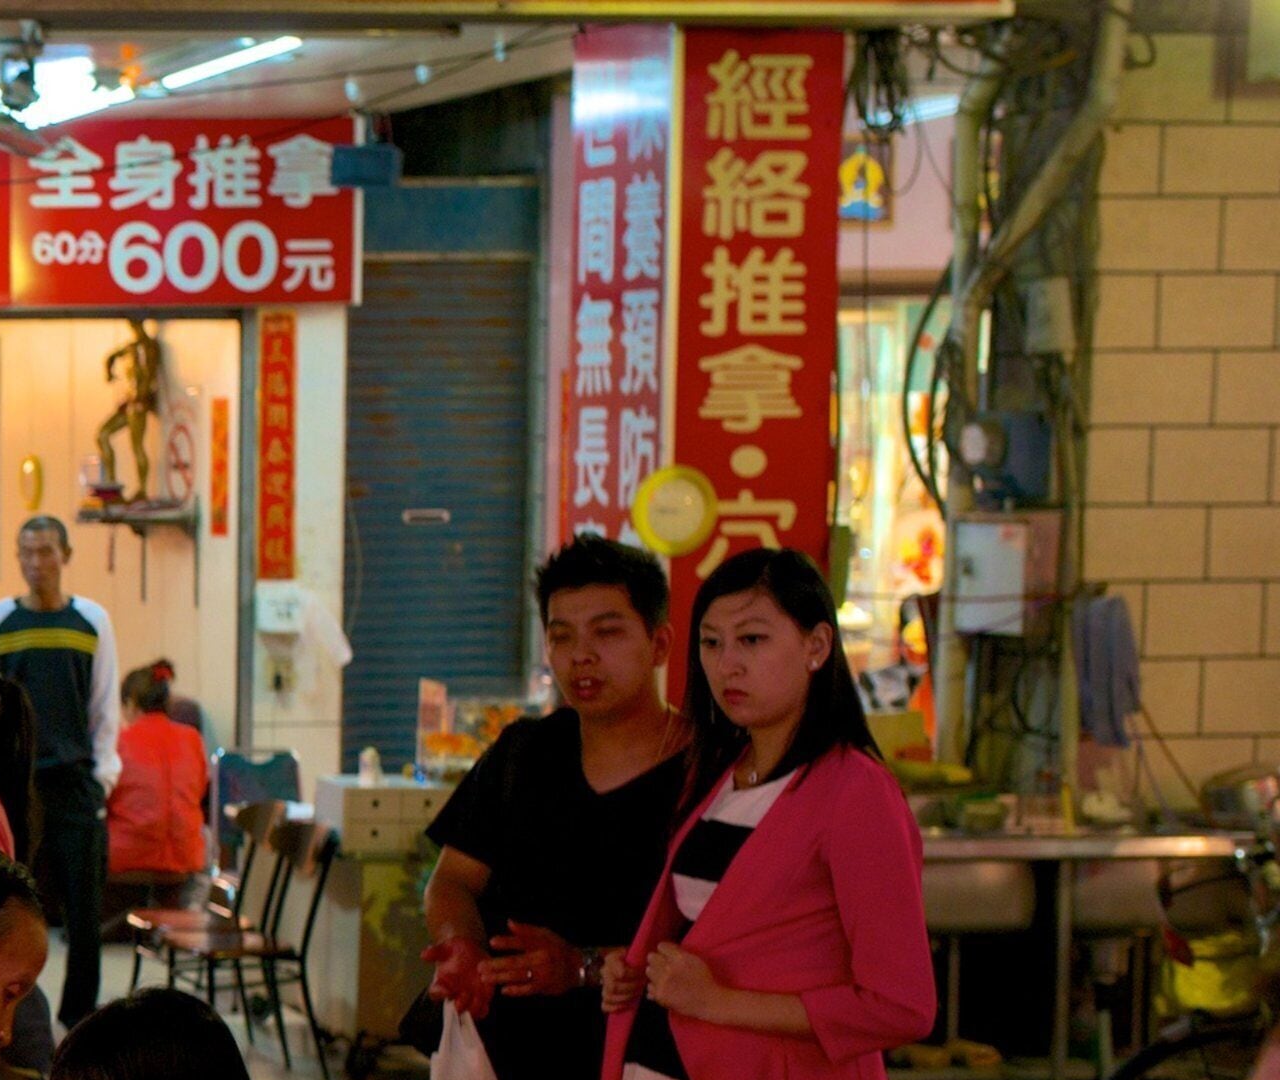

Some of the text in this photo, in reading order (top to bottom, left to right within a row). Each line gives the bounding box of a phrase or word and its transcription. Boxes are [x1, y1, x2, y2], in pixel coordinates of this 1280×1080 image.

[28, 133, 340, 211] 全身推拿
[31, 219, 335, 295] 60分 600元
